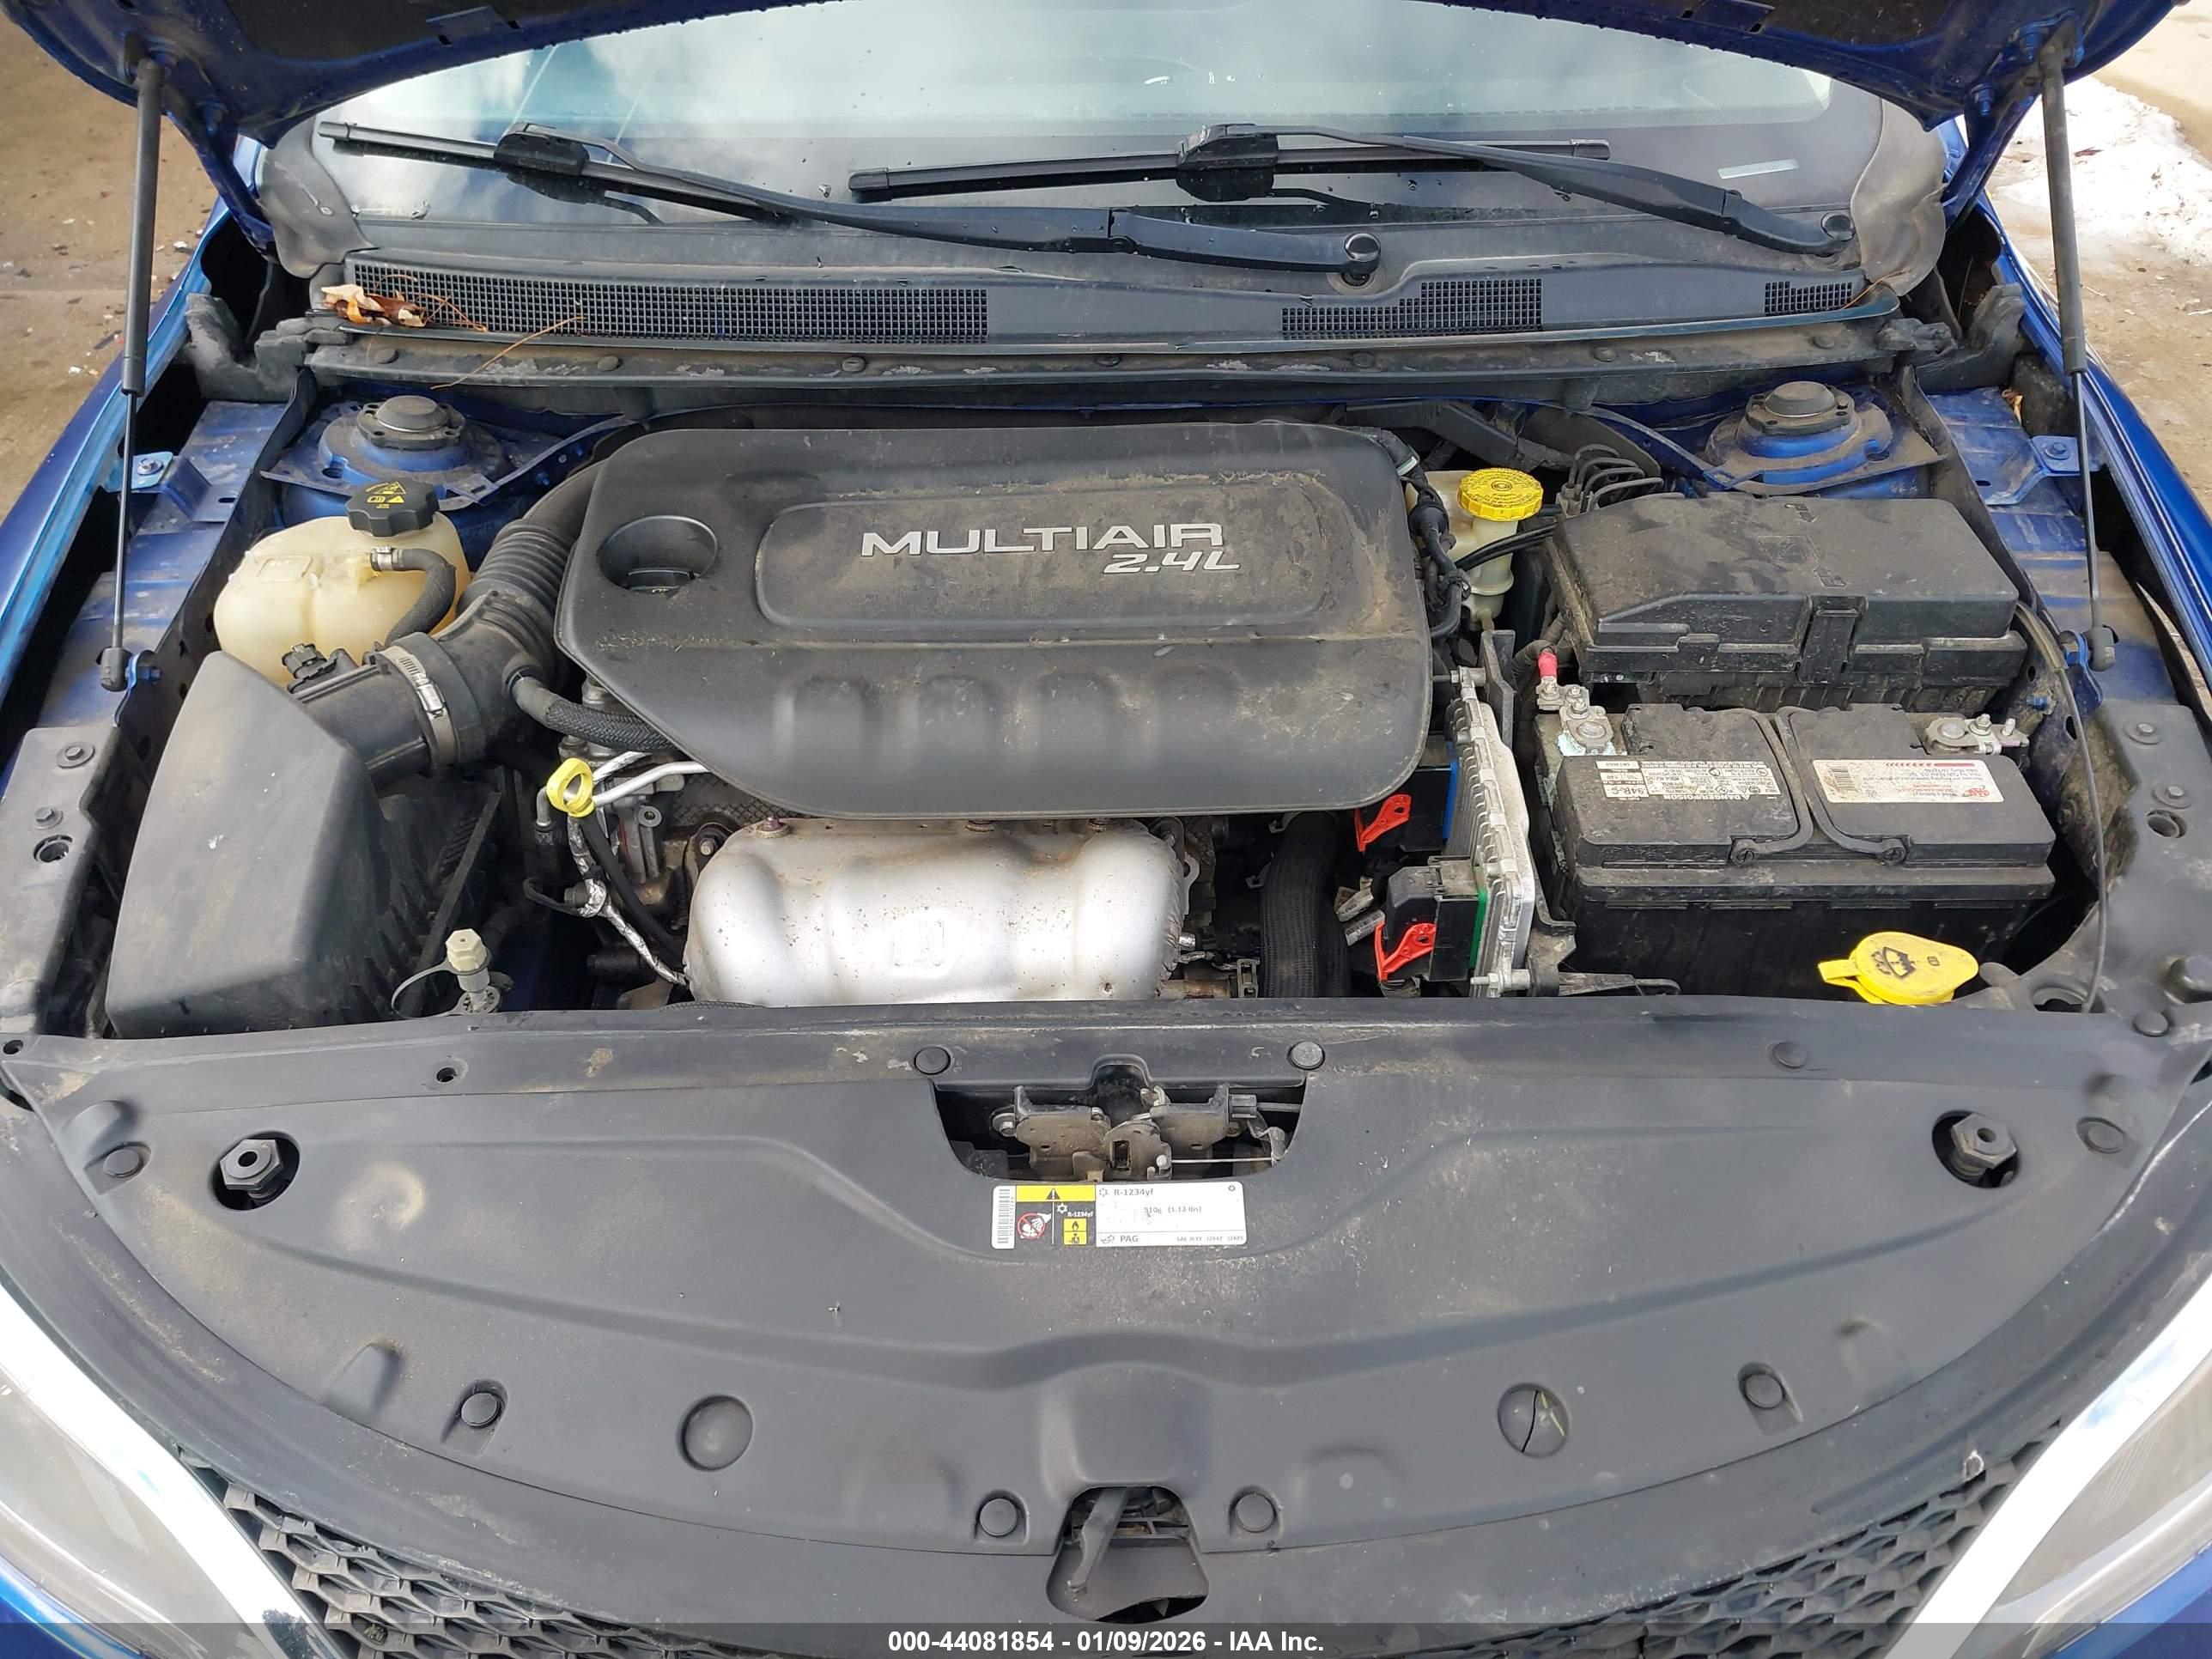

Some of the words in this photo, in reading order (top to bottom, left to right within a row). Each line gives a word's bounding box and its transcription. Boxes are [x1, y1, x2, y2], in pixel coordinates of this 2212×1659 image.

[861, 523, 1223, 556] MULTIAIR
[1103, 550, 1241, 574] 2.4L
[1611, 787, 1644, 795] 94R-C
[1114, 1188, 1154, 1197] R-1234yf
[1067, 1210, 1094, 1218] R-1234yf
